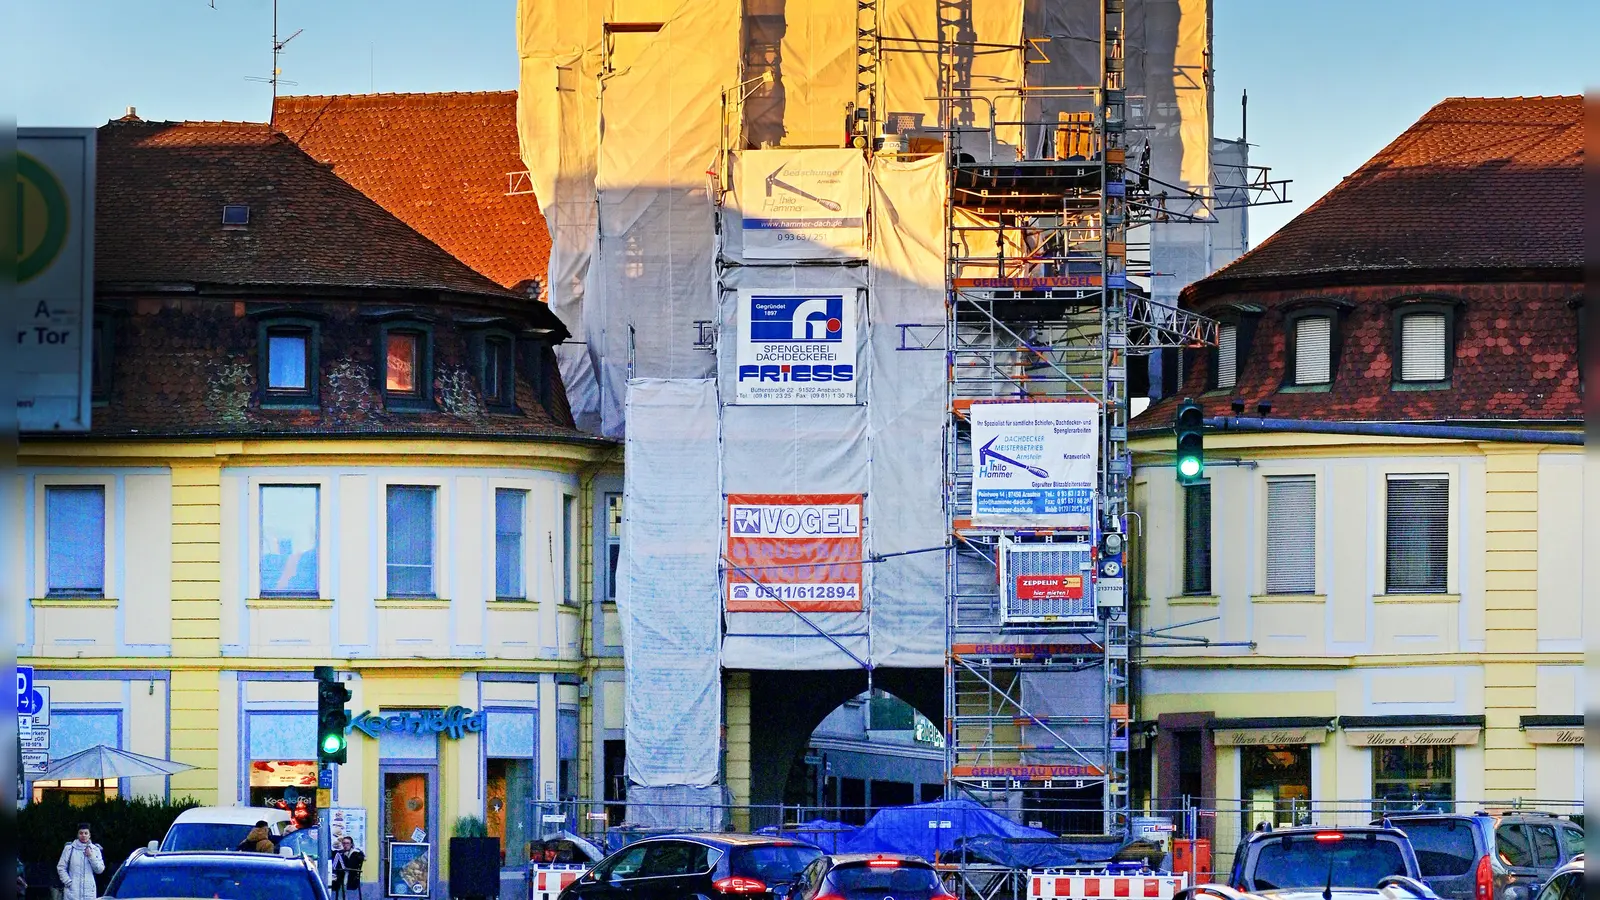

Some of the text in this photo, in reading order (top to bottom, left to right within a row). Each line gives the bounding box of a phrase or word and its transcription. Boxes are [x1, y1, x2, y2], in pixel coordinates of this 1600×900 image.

[762, 198, 804, 212] Hammer
[760, 219, 843, 228] www.hammer-dach.de
[777, 233, 783, 241] 0
[784, 233, 795, 241] 93
[796, 233, 806, 241] 63
[813, 233, 827, 241] 251
[1051, 275, 1093, 286] VOGEL
[755, 303, 786, 311] Gegründet
[34, 326, 70, 345] Tor
[763, 344, 830, 353] SPENGLEREI
[756, 353, 837, 361] DACHDECKEREI
[988, 459, 1007, 471] Thilo
[979, 466, 1013, 479] Hammer
[763, 507, 858, 534] VOGEL
[755, 586, 856, 599] 0911/612894
[1232, 731, 1309, 744] Uhren & Schmuck
[1366, 732, 1459, 745] Uhren & Schmuck
[1050, 766, 1089, 776] VOGEL
